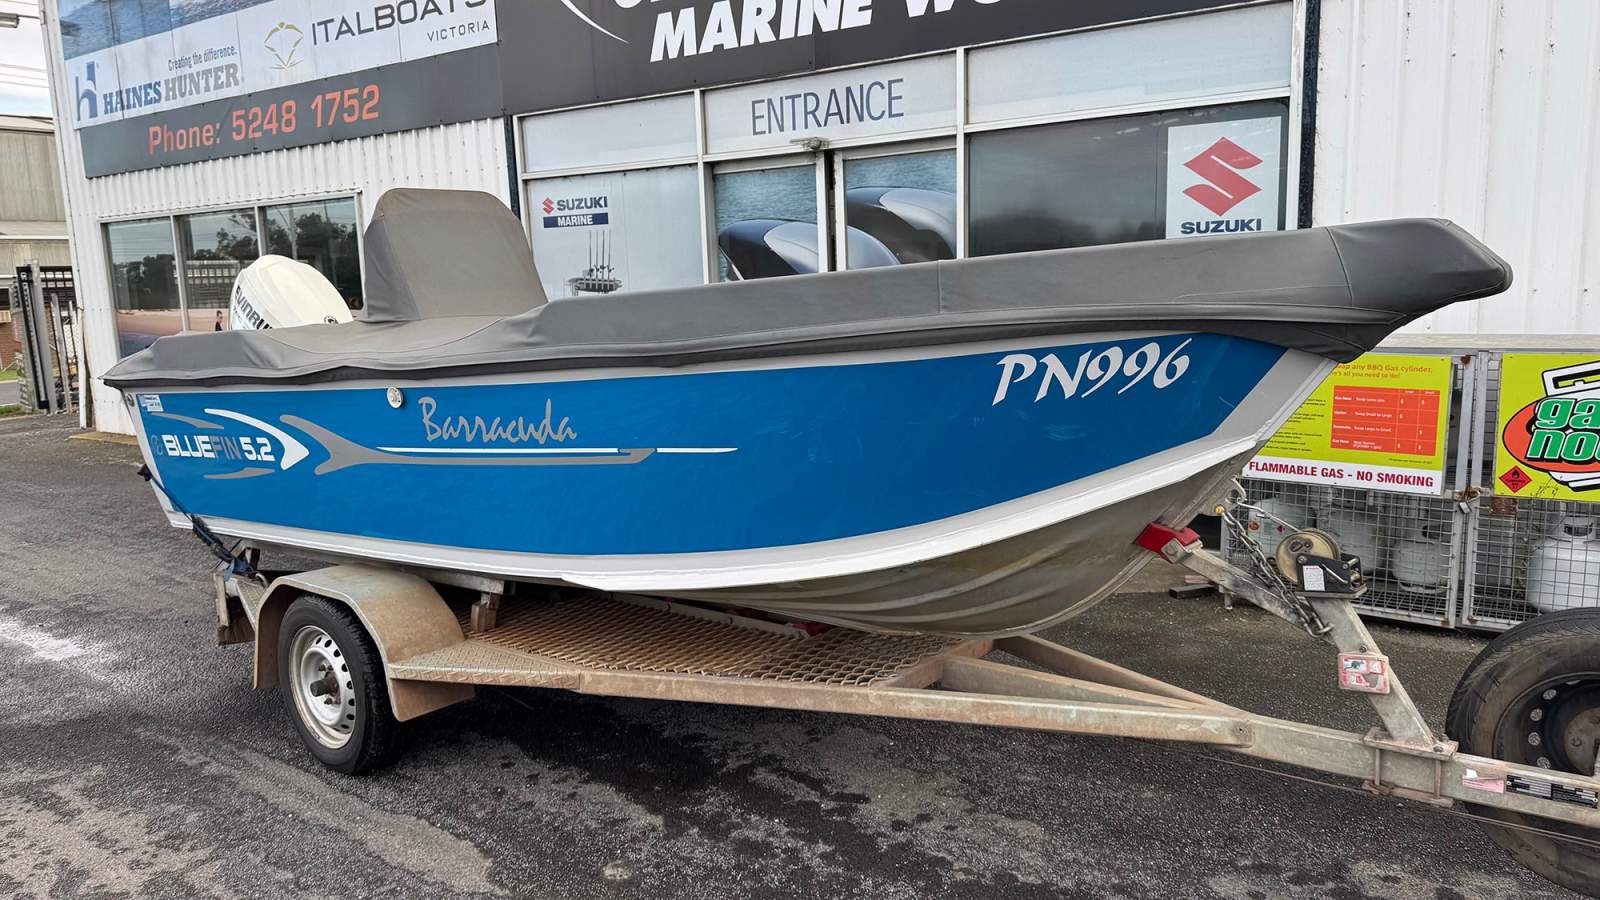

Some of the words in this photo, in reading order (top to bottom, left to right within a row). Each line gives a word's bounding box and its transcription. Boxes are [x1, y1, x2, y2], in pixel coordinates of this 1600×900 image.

[427, 20, 490, 42] VICTORIA
[649, 0, 873, 62] MARINE
[168, 54, 193, 72] Creating
[192, 51, 203, 65] the
[203, 45, 238, 62] difference.
[103, 81, 162, 115] HAINES
[164, 63, 240, 101] HUNTER
[148, 123, 221, 155] Phone:
[232, 106, 297, 141] 5248
[311, 84, 381, 128] 1752
[751, 78, 904, 136] ENTRANCE
[556, 196, 608, 211] SUZUKI
[557, 214, 594, 227] MARINE
[1180, 218, 1262, 235] SUZUKI
[234, 285, 273, 330] EVINRU
[992, 337, 1193, 406] PN996
[1366, 363, 1383, 371] BBQ
[418, 396, 577, 445] Barracuda
[161, 434, 242, 460] BLUEFIN
[239, 436, 276, 462] 5.2
[1526, 429, 1600, 461] no
[1249, 461, 1318, 477] FLAMMABLE
[1321, 467, 1344, 479] GAS
[1356, 471, 1373, 482] NO
[1377, 473, 1434, 488] SMOKING
